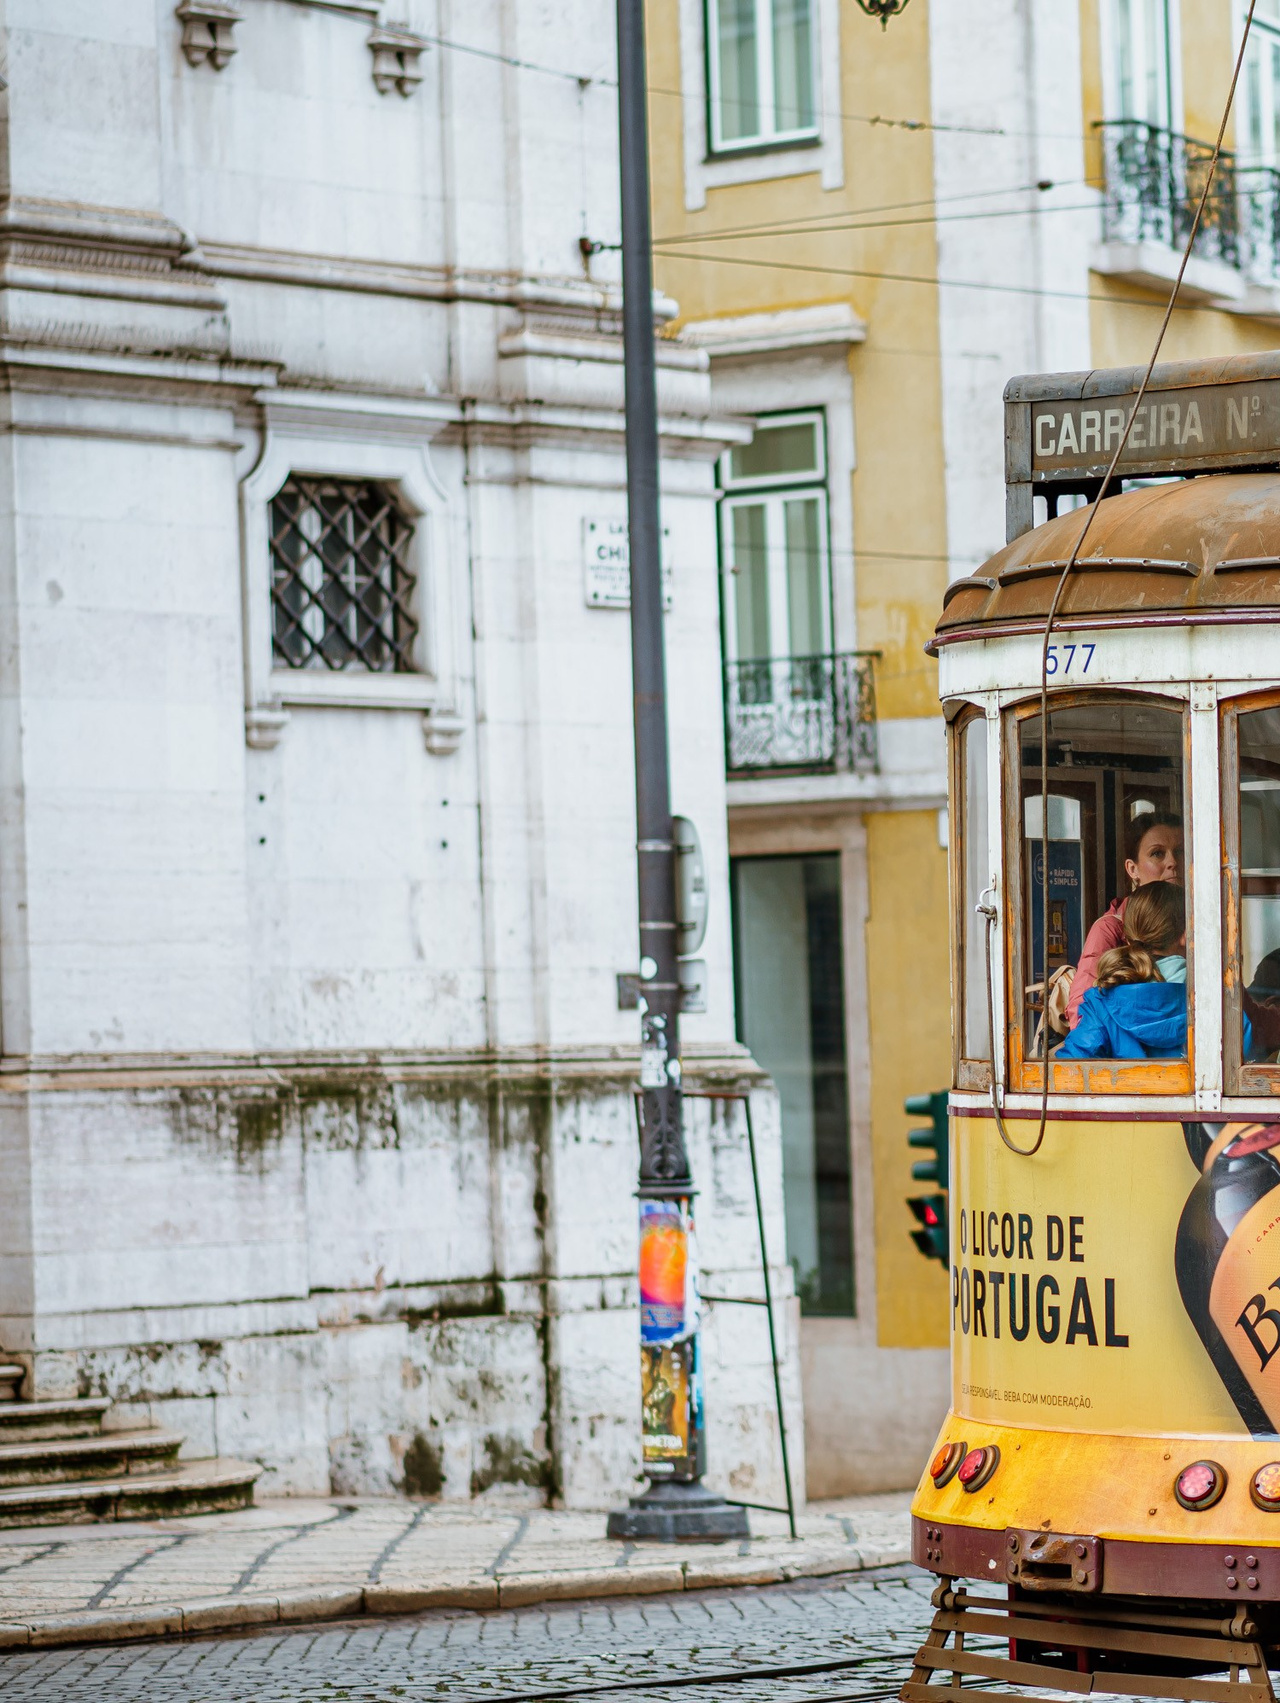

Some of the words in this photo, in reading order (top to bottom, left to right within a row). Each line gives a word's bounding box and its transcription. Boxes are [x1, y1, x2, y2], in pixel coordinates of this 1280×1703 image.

[1035, 401, 1204, 457] CARREIRA
[609, 523, 624, 534] LA
[597, 545, 625, 561] CHI
[1045, 643, 1097, 675] 577
[1054, 877, 1079, 886] SIMPLES
[960, 1208, 967, 1254] O
[972, 1210, 1034, 1260] LICOR
[1046, 1215, 1085, 1262] DE
[953, 1265, 1130, 1348] PORTUGAL
[1003, 1390, 1021, 1402] BEBA
[1022, 1392, 1038, 1404] COM
[1040, 1394, 1093, 1410] MODERAÇÃO.
